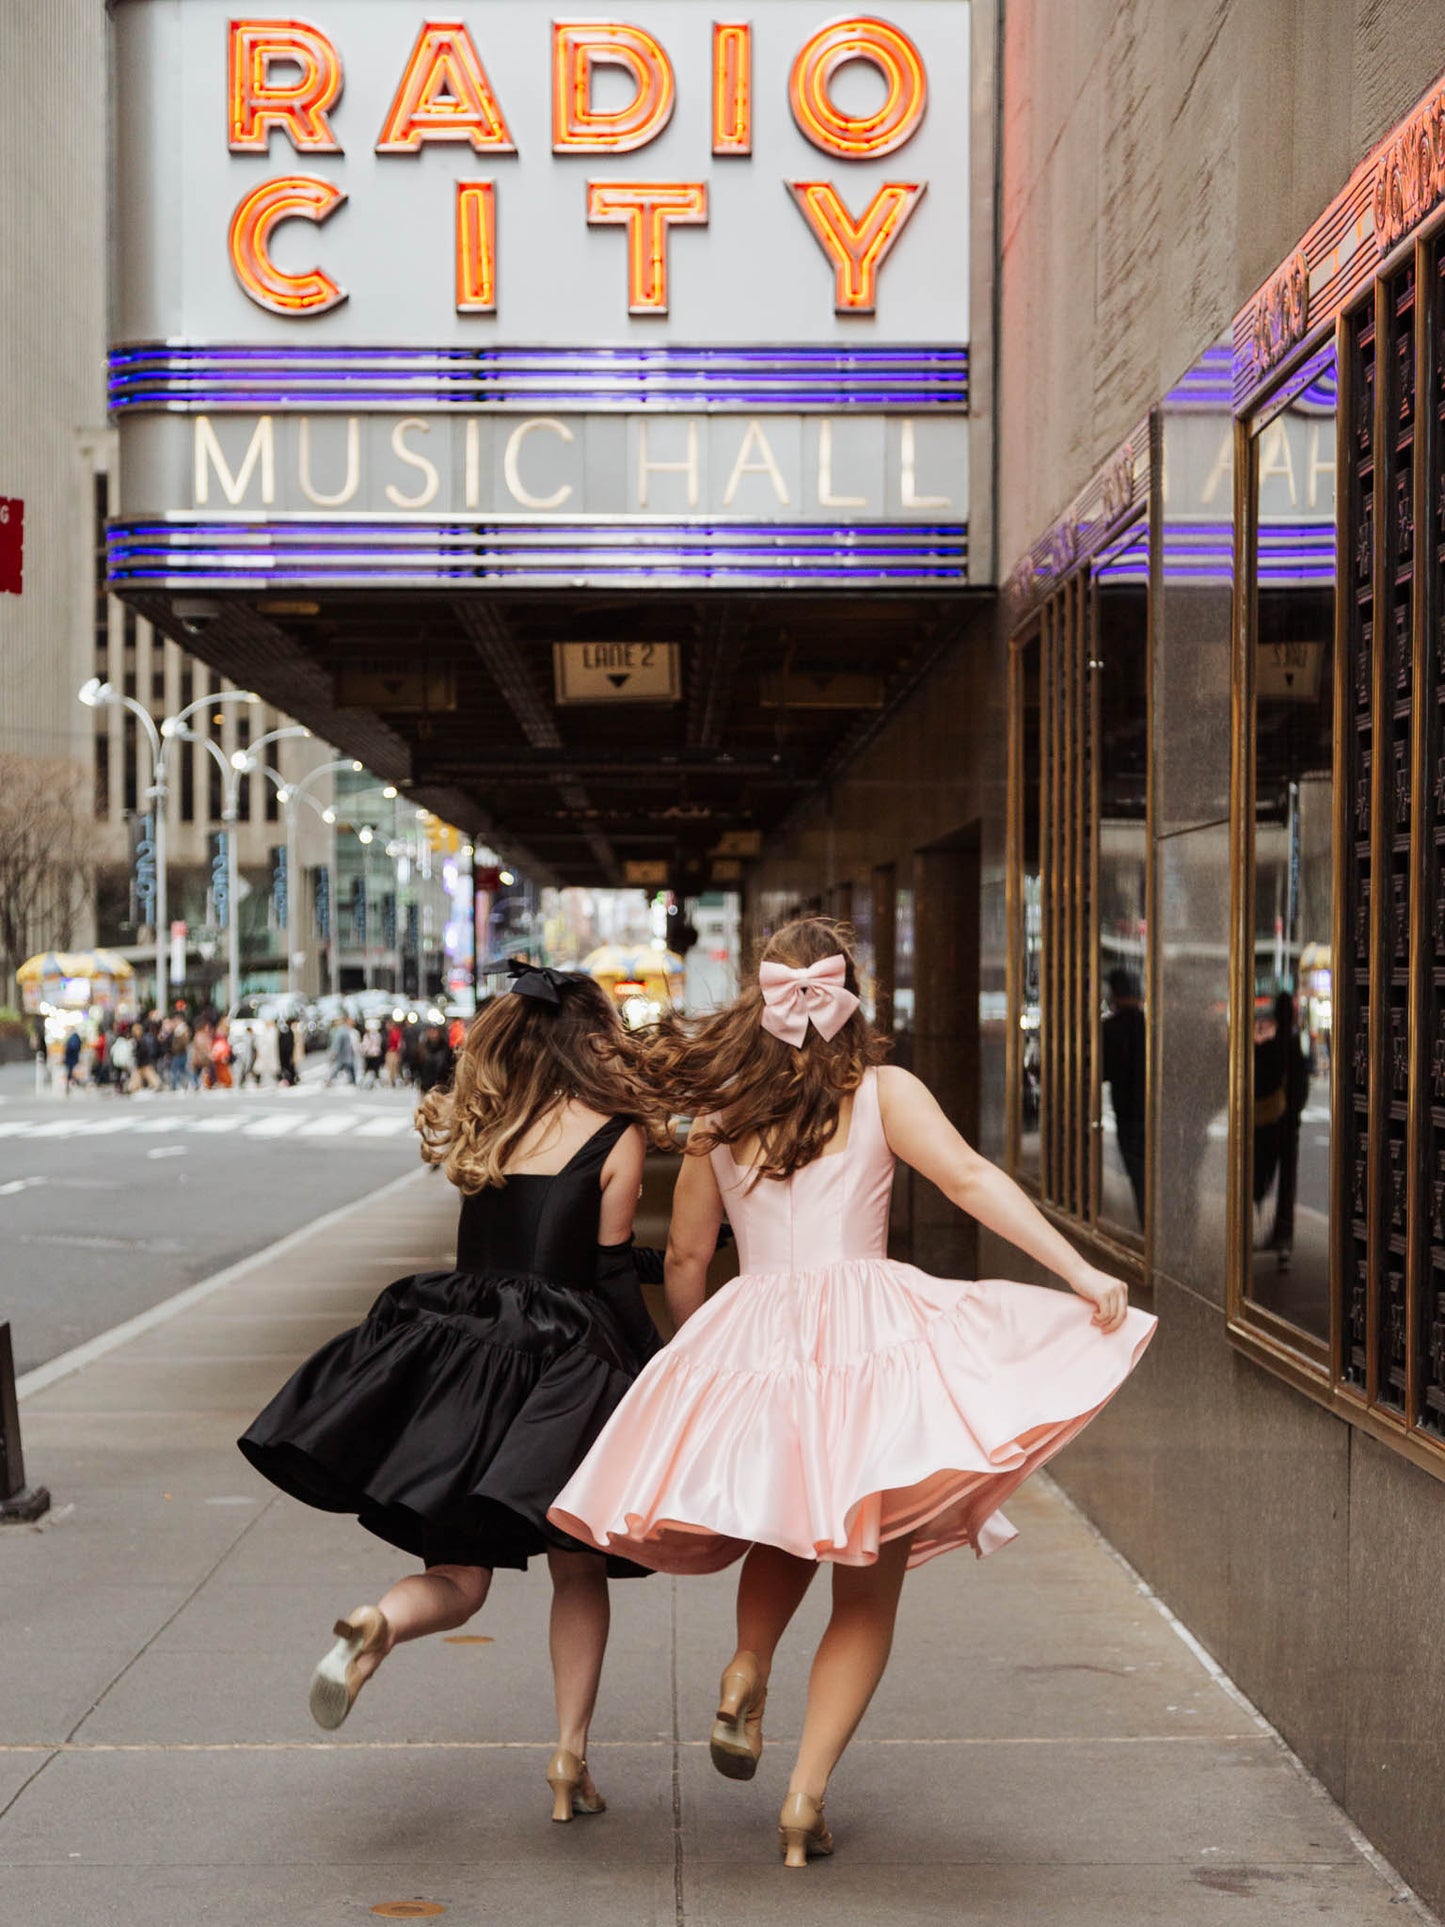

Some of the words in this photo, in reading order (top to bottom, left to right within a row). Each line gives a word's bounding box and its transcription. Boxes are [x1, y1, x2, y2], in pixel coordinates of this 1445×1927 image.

[227, 14, 928, 160] RADIO
[227, 176, 928, 316] CITY
[195, 416, 575, 509] MUSIC
[638, 417, 953, 509] HALL
[582, 642, 636, 669] LANE
[641, 642, 655, 667] 2
